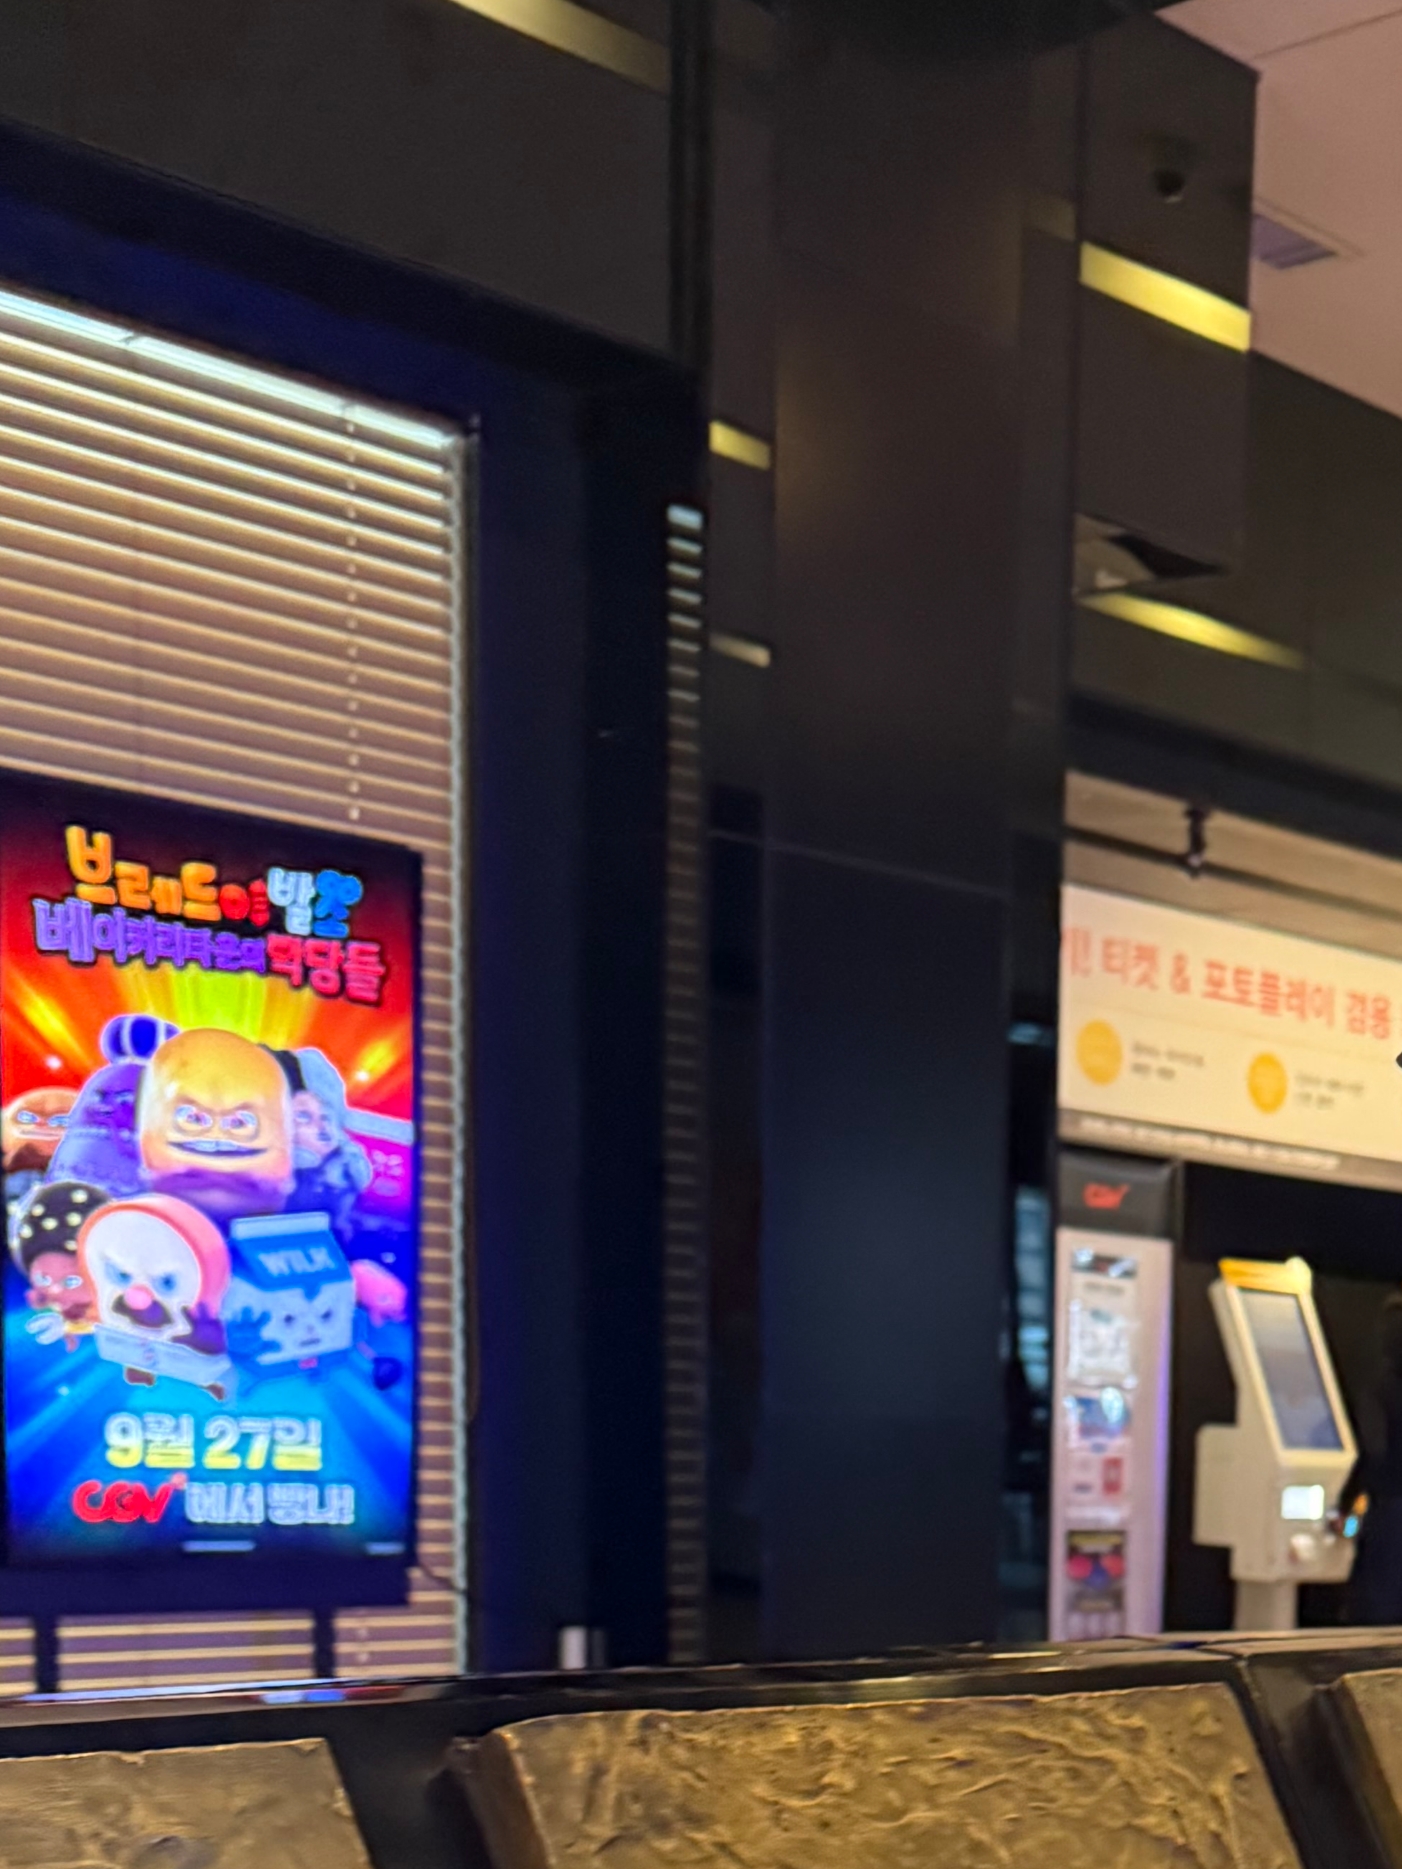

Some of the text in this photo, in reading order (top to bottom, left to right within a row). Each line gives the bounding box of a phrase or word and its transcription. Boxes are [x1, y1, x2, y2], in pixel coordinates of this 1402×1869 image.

[1169, 950, 1192, 994] &
[1200, 959, 1336, 1028] 포토플레이
[104, 1412, 322, 1471] 9월 27일
[72, 1472, 188, 1524] CGV
